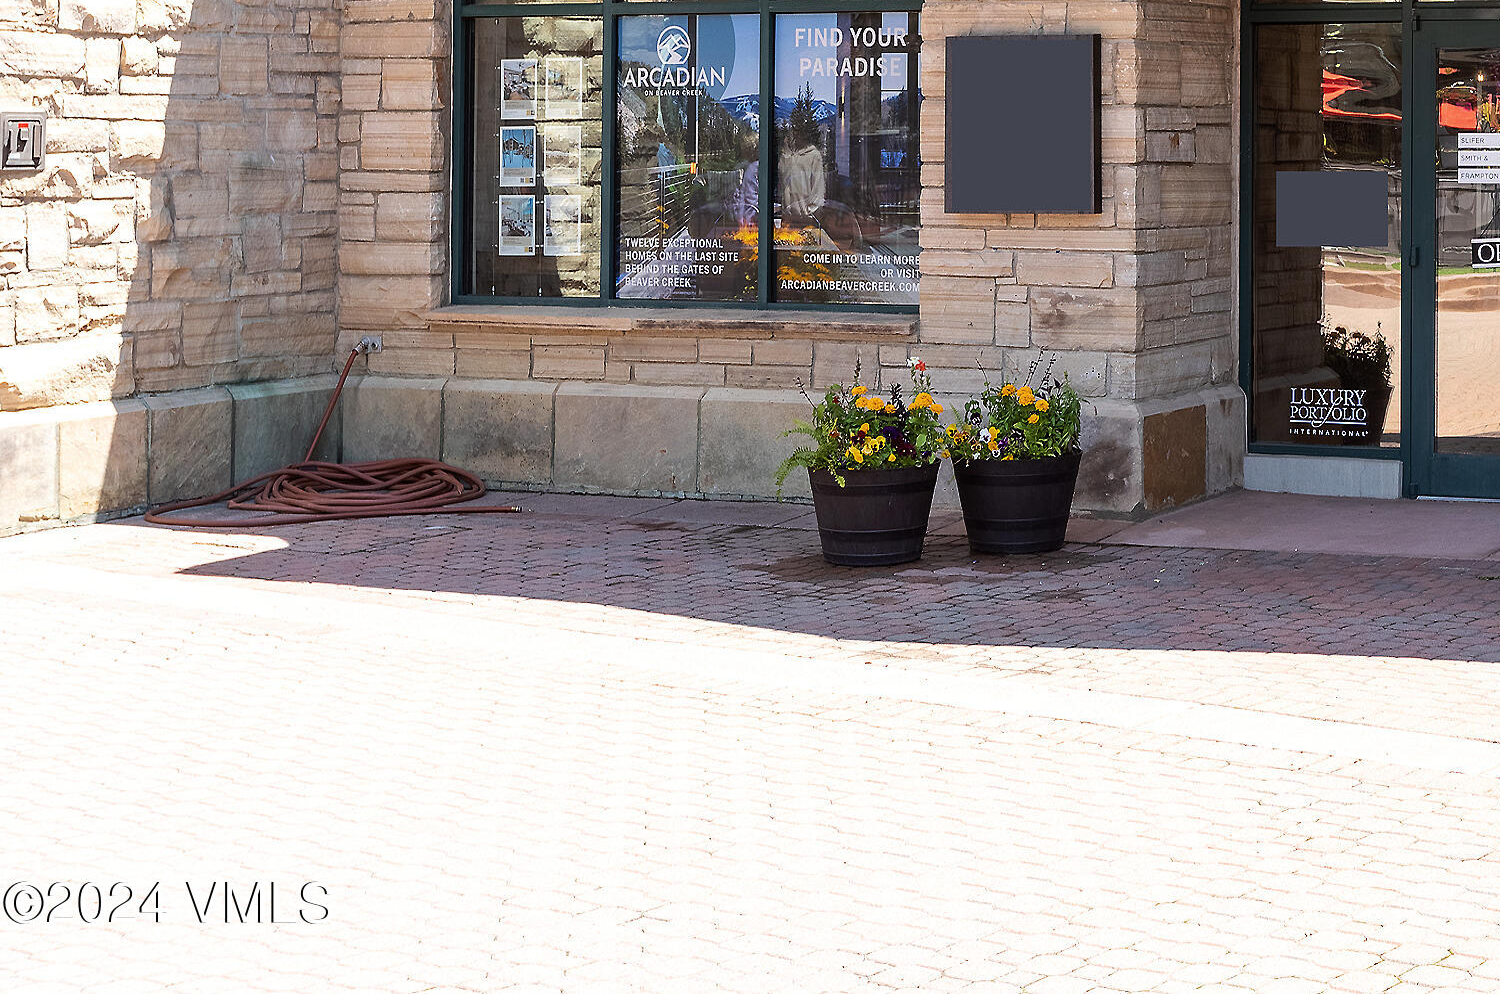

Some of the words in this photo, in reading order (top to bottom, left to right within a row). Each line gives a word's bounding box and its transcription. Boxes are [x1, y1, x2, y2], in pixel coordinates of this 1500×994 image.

[795, 27, 844, 47] FIND
[849, 27, 907, 47] YOUR
[799, 57, 902, 77] PARADISE
[622, 66, 725, 87] ARCADIAN
[644, 89, 653, 97] ON
[655, 89, 680, 97] BEAVER
[682, 89, 704, 97] CREEK
[625, 237, 660, 248] TWELVE
[662, 238, 724, 249] EXCEPTIONAL
[625, 250, 657, 261] HOMES
[659, 251, 672, 261] ON
[674, 251, 693, 262] THE
[694, 251, 717, 262] LAST
[718, 251, 739, 262] SITE
[803, 253, 830, 264] COME
[832, 253, 843, 264] IN
[845, 254, 858, 264] TO
[859, 254, 891, 265] LEARN
[893, 254, 920, 265] MORE
[625, 263, 660, 274] BEHIND
[662, 264, 680, 274] THE
[681, 264, 710, 275] GATES
[711, 265, 725, 275] OF
[880, 268, 894, 278] OR
[896, 268, 920, 279] VISIT
[625, 277, 660, 287] BEAVER
[661, 277, 691, 287] CREEK
[781, 279, 920, 292] ARCADIANBEAVERCREEK.COM
[1290, 387, 1367, 406] LUXURY
[1289, 405, 1367, 426] PORTFOLIO
